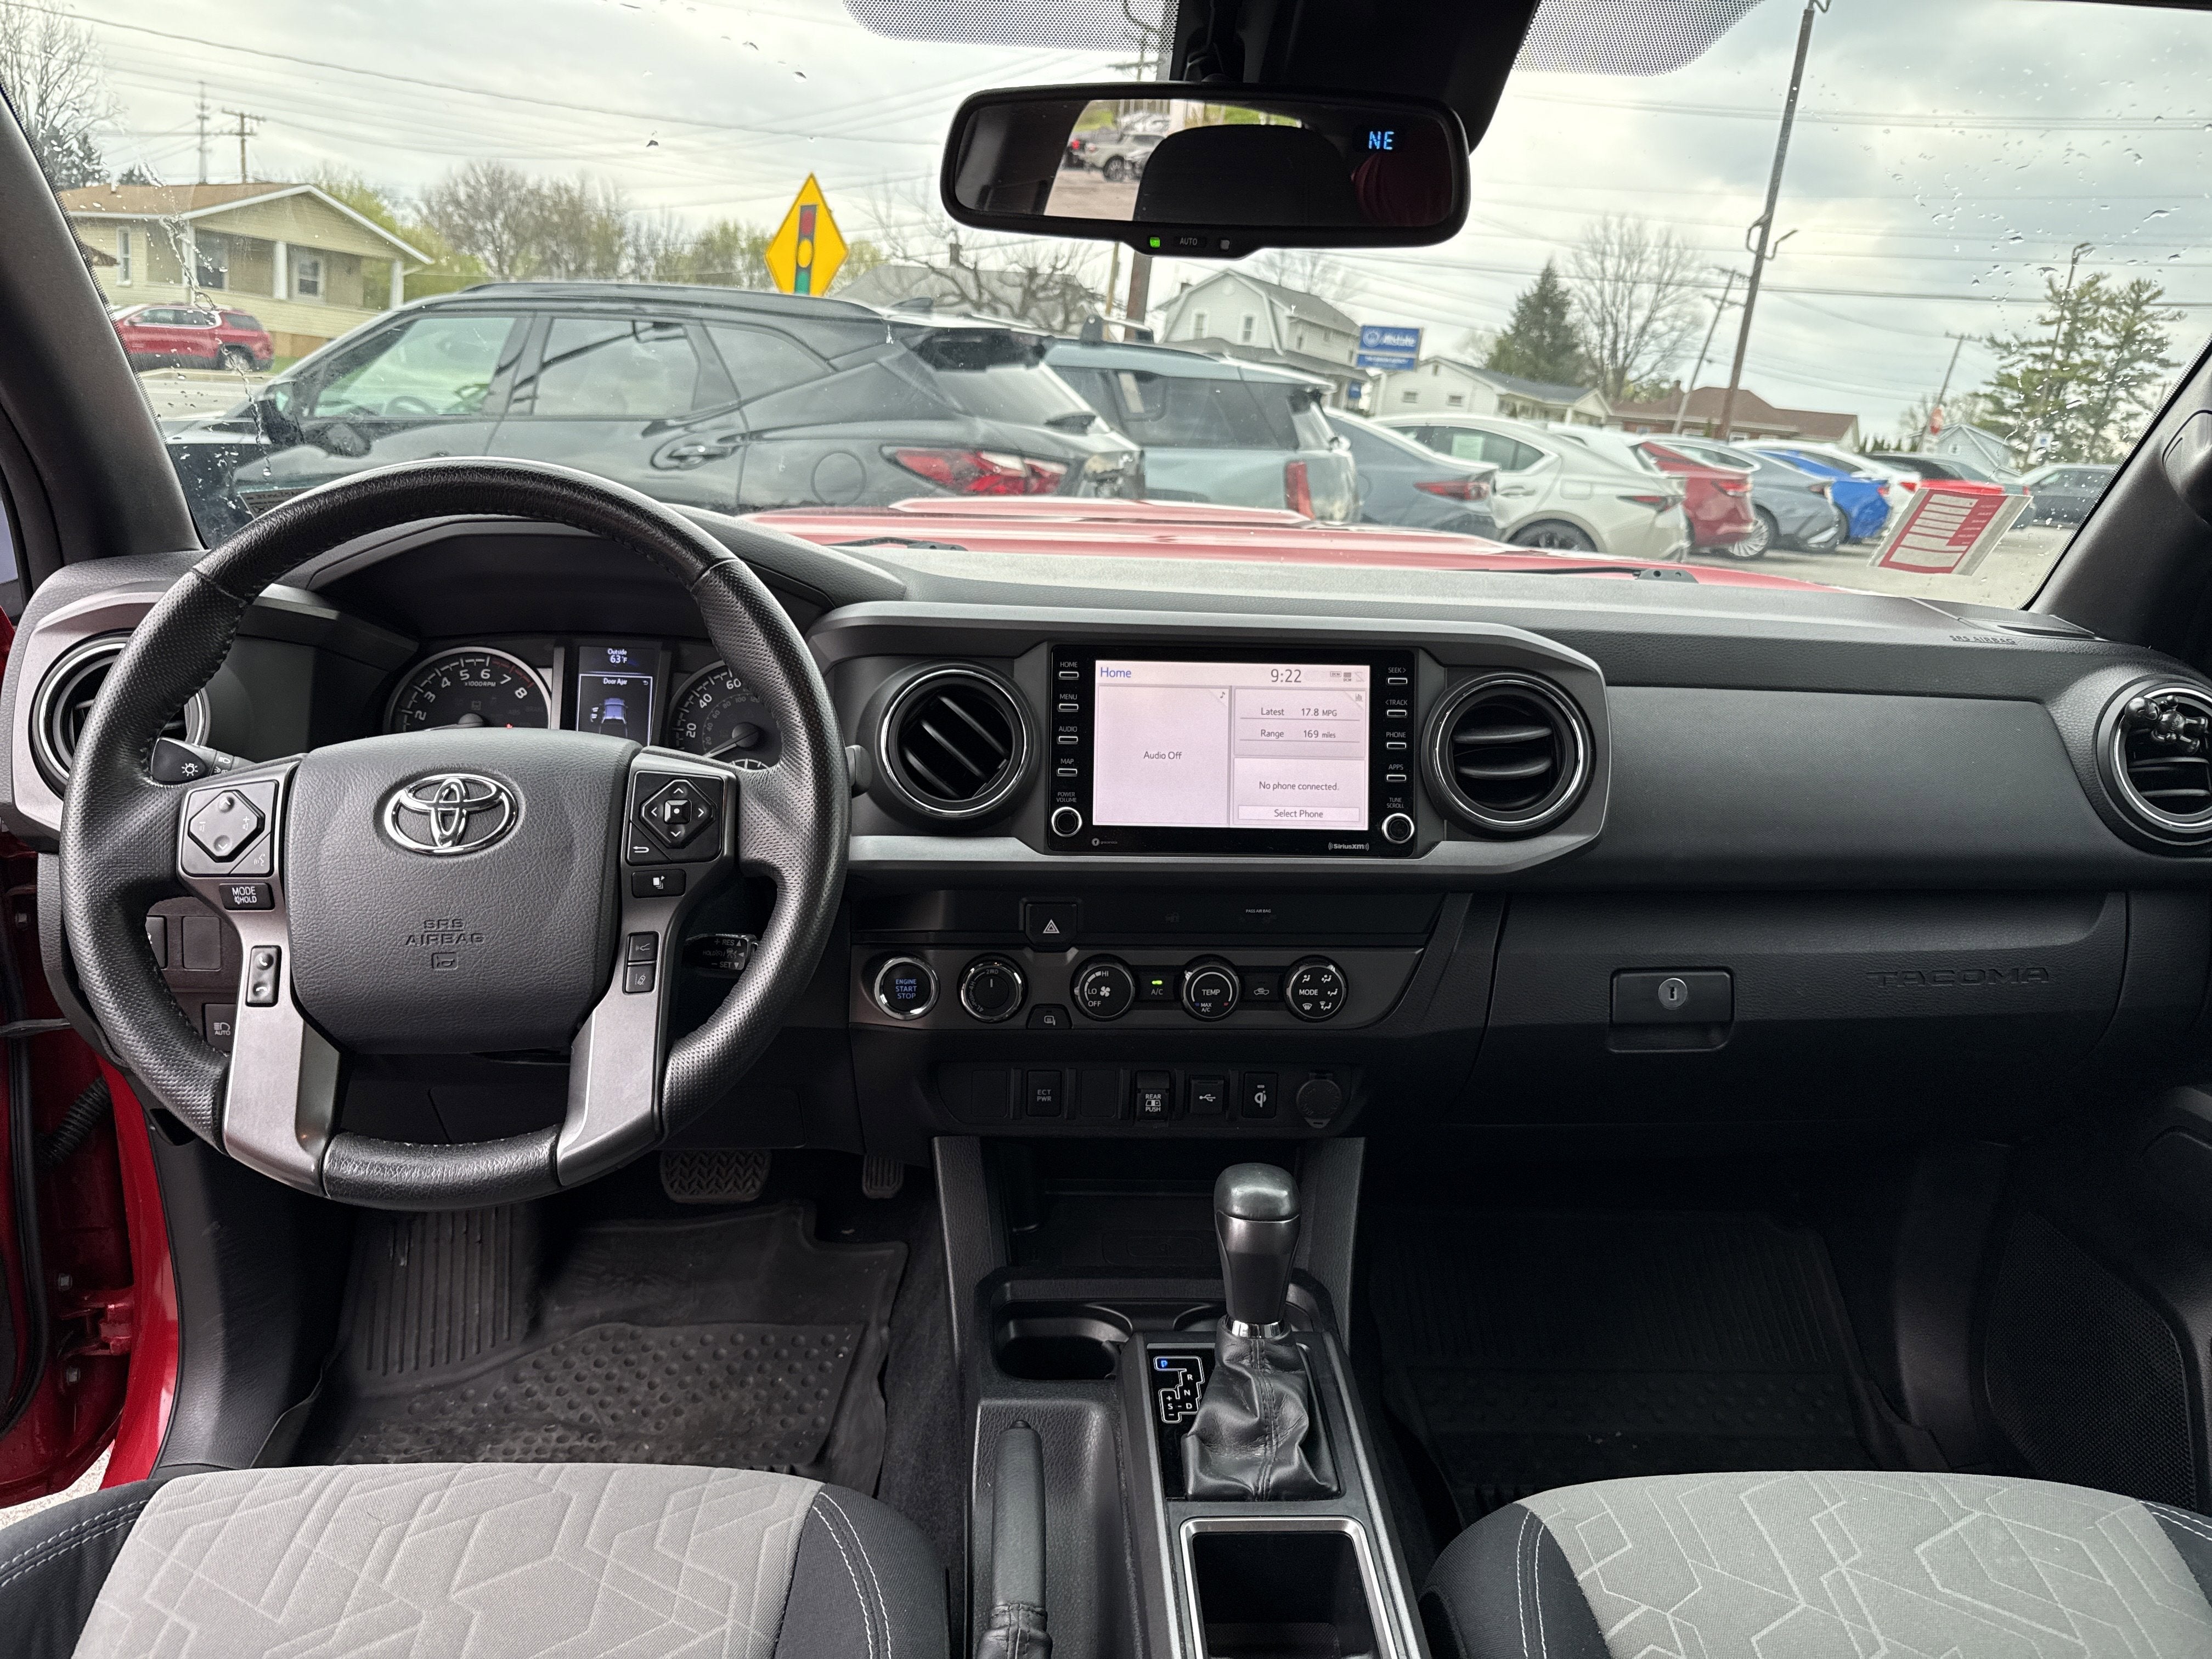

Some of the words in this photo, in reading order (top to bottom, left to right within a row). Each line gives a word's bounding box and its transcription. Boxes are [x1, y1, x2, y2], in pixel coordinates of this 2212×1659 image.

[1368, 131, 1394, 150] NE
[1179, 238, 1198, 246] AUTO
[459, 669, 470, 680] 5
[481, 669, 491, 679] 6
[500, 674, 512, 685] 7
[1100, 667, 1132, 678] Home
[1271, 669, 1301, 683] 9:22
[441, 677, 451, 689] 4
[726, 678, 742, 690] 60
[424, 691, 436, 703] 3
[515, 687, 528, 699] 8
[699, 693, 713, 709] 40
[415, 710, 426, 721] 2
[1261, 708, 1284, 716] Latest
[1301, 708, 1319, 716] 17.8
[686, 723, 697, 738] 20
[1261, 730, 1284, 739] Range
[1259, 781, 1271, 789] No
[1273, 782, 1296, 791] phone
[1297, 782, 1339, 791] connected.
[1274, 809, 1297, 817] Select
[1300, 810, 1323, 818] Phone
[232, 887, 257, 896] MODE
[405, 933, 486, 946] AIRBAG
[1866, 967, 2049, 987] TACOMA
